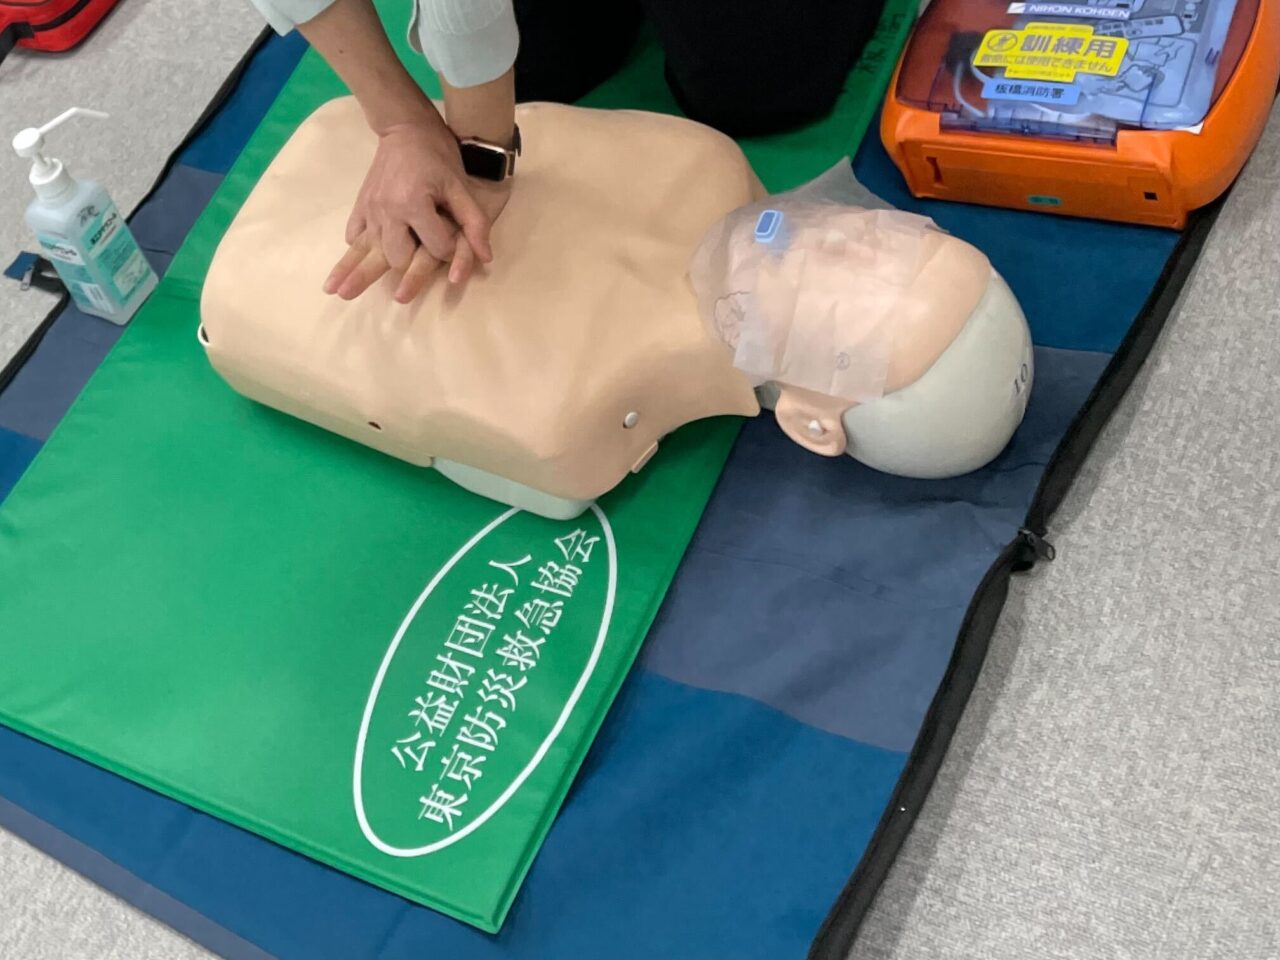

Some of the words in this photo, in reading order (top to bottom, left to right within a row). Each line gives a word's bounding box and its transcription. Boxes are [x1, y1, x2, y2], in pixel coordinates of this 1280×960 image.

[1029, 4, 1073, 14] NIHON
[1074, 5, 1131, 18] KOHDEN
[1020, 34, 1118, 59] 訓練用
[980, 53, 1114, 72] には使用できません
[391, 553, 532, 772] 公益財団法人
[418, 527, 601, 830] 東京防災救急協会
